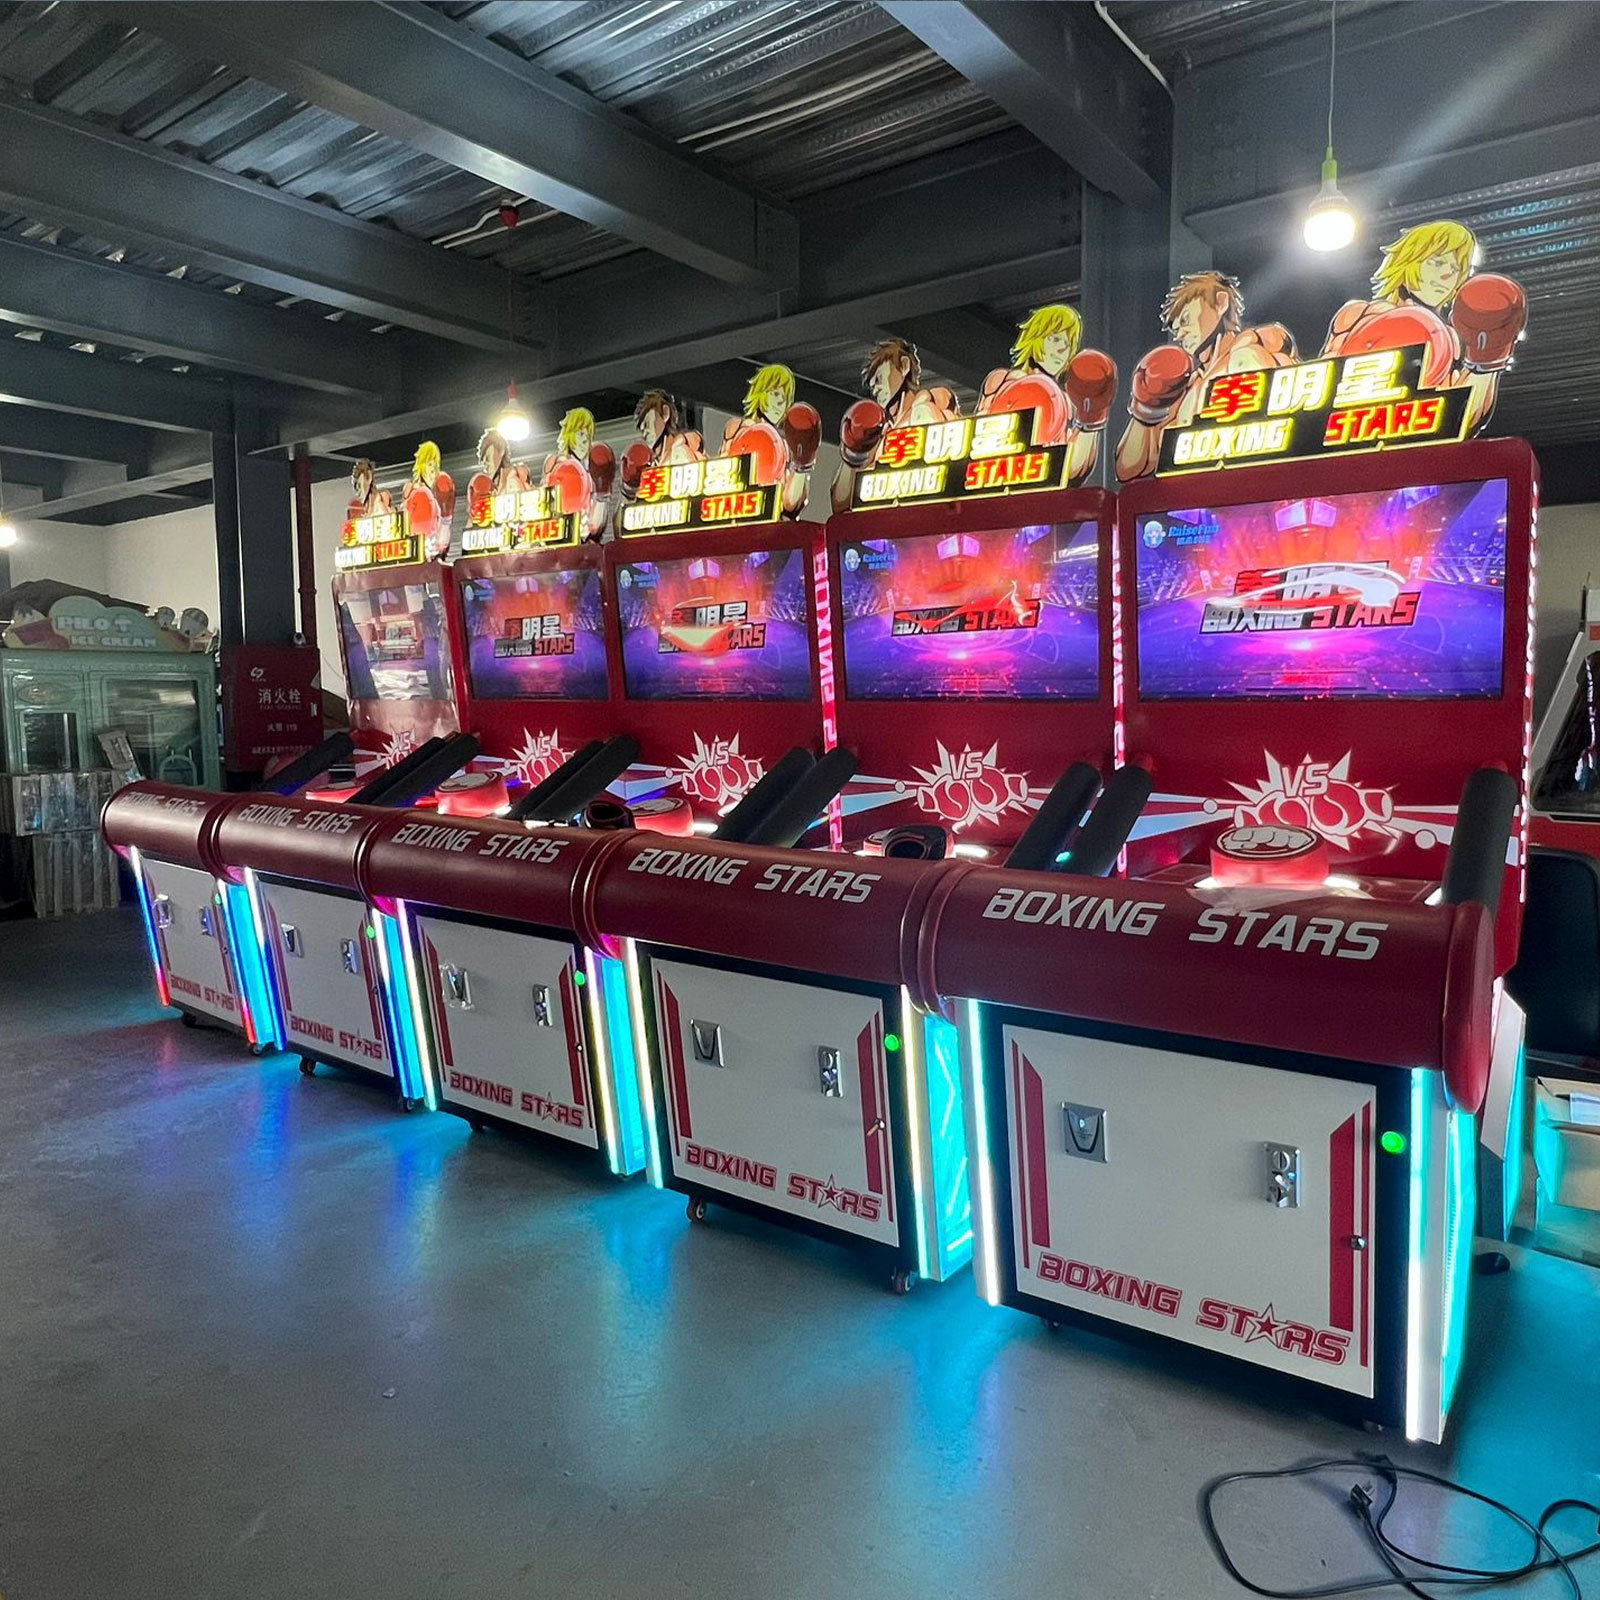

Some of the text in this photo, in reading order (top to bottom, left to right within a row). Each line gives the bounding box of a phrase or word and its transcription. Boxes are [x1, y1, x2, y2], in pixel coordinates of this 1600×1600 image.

[1202, 349, 1408, 422] 拳明星
[1174, 397, 1444, 465] BOXING STARS
[859, 452, 1049, 501] BOXING STARS
[700, 490, 762, 521] STARS
[534, 635, 574, 654] STARS
[258, 688, 301, 704] 消火栓
[532, 736, 550, 757] VS
[704, 741, 730, 767] VS
[950, 751, 983, 780] VS
[1282, 762, 1330, 797] VS
[238, 804, 362, 834] BOXING STARS
[391, 823, 569, 863] BOXING STARS
[628, 848, 881, 904] BOXING STARS
[982, 888, 1388, 960] BOXING STARS
[291, 1015, 334, 1044] BOXING
[450, 1071, 513, 1110] BOXING
[684, 1142, 776, 1191] BOXING
[1036, 1251, 1182, 1318] BOXING
